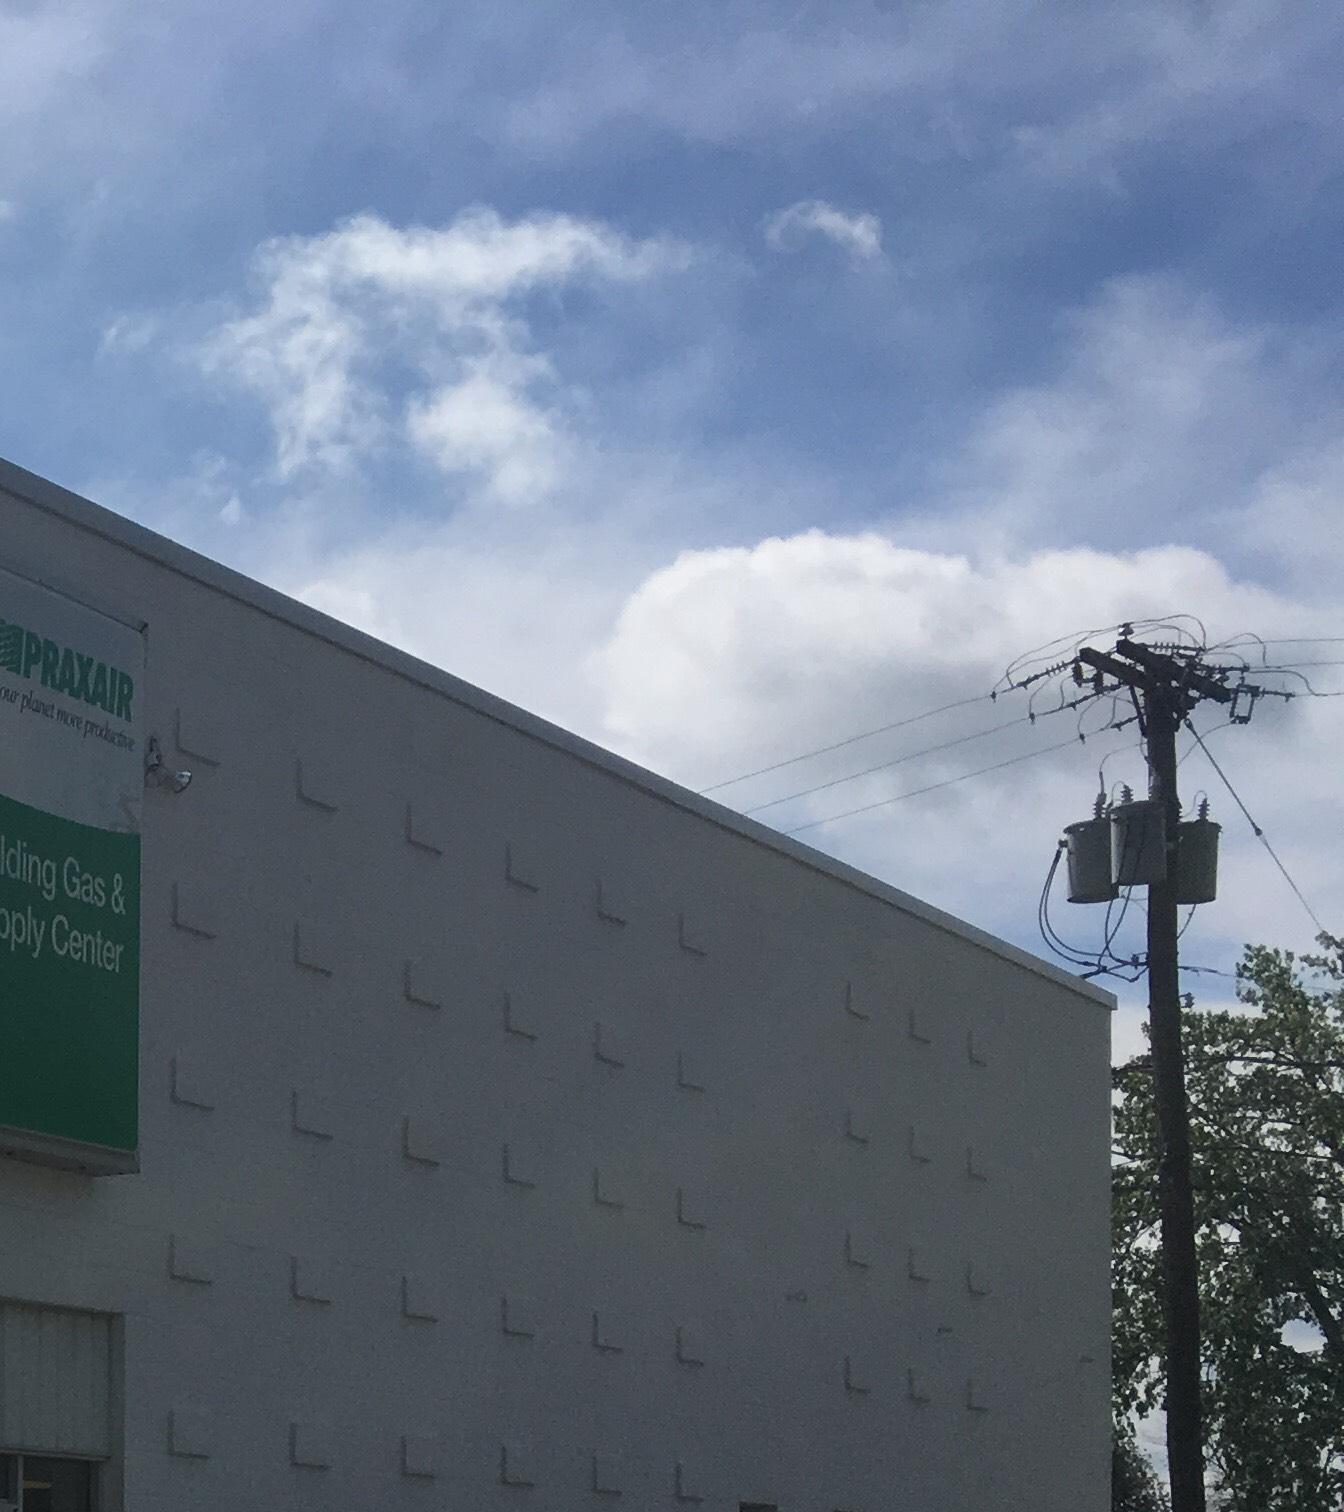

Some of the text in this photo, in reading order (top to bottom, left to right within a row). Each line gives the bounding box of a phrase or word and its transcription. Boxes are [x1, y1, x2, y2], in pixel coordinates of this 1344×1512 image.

[23, 631, 134, 723] PRAXAIR
[0, 685, 20, 703] our
[20, 690, 54, 721] planet
[56, 709, 83, 730] more
[83, 718, 136, 751] productive
[64, 856, 105, 907] Gas
[112, 873, 126, 915] &
[52, 914, 125, 973] Center
